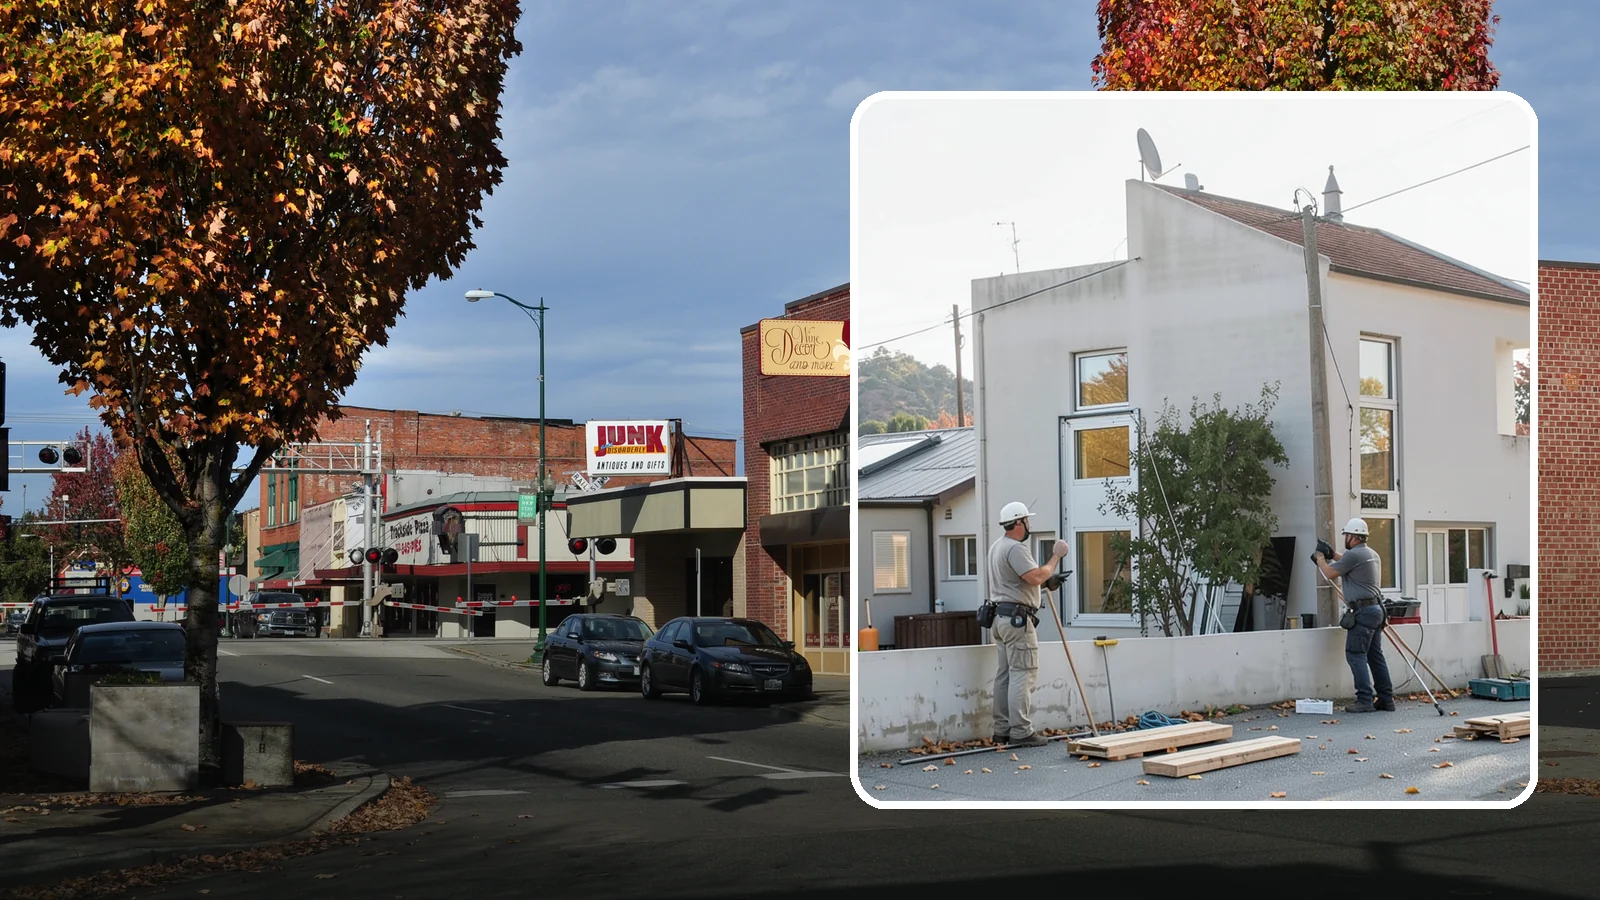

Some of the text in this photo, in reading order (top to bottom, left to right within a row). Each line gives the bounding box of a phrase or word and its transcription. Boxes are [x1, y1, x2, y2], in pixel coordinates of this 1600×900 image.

[596, 426, 665, 457] JUNK
[596, 460, 665, 470] ANTIQUES AND GIFTS
[390, 520, 429, 539] Trackside Pizza
